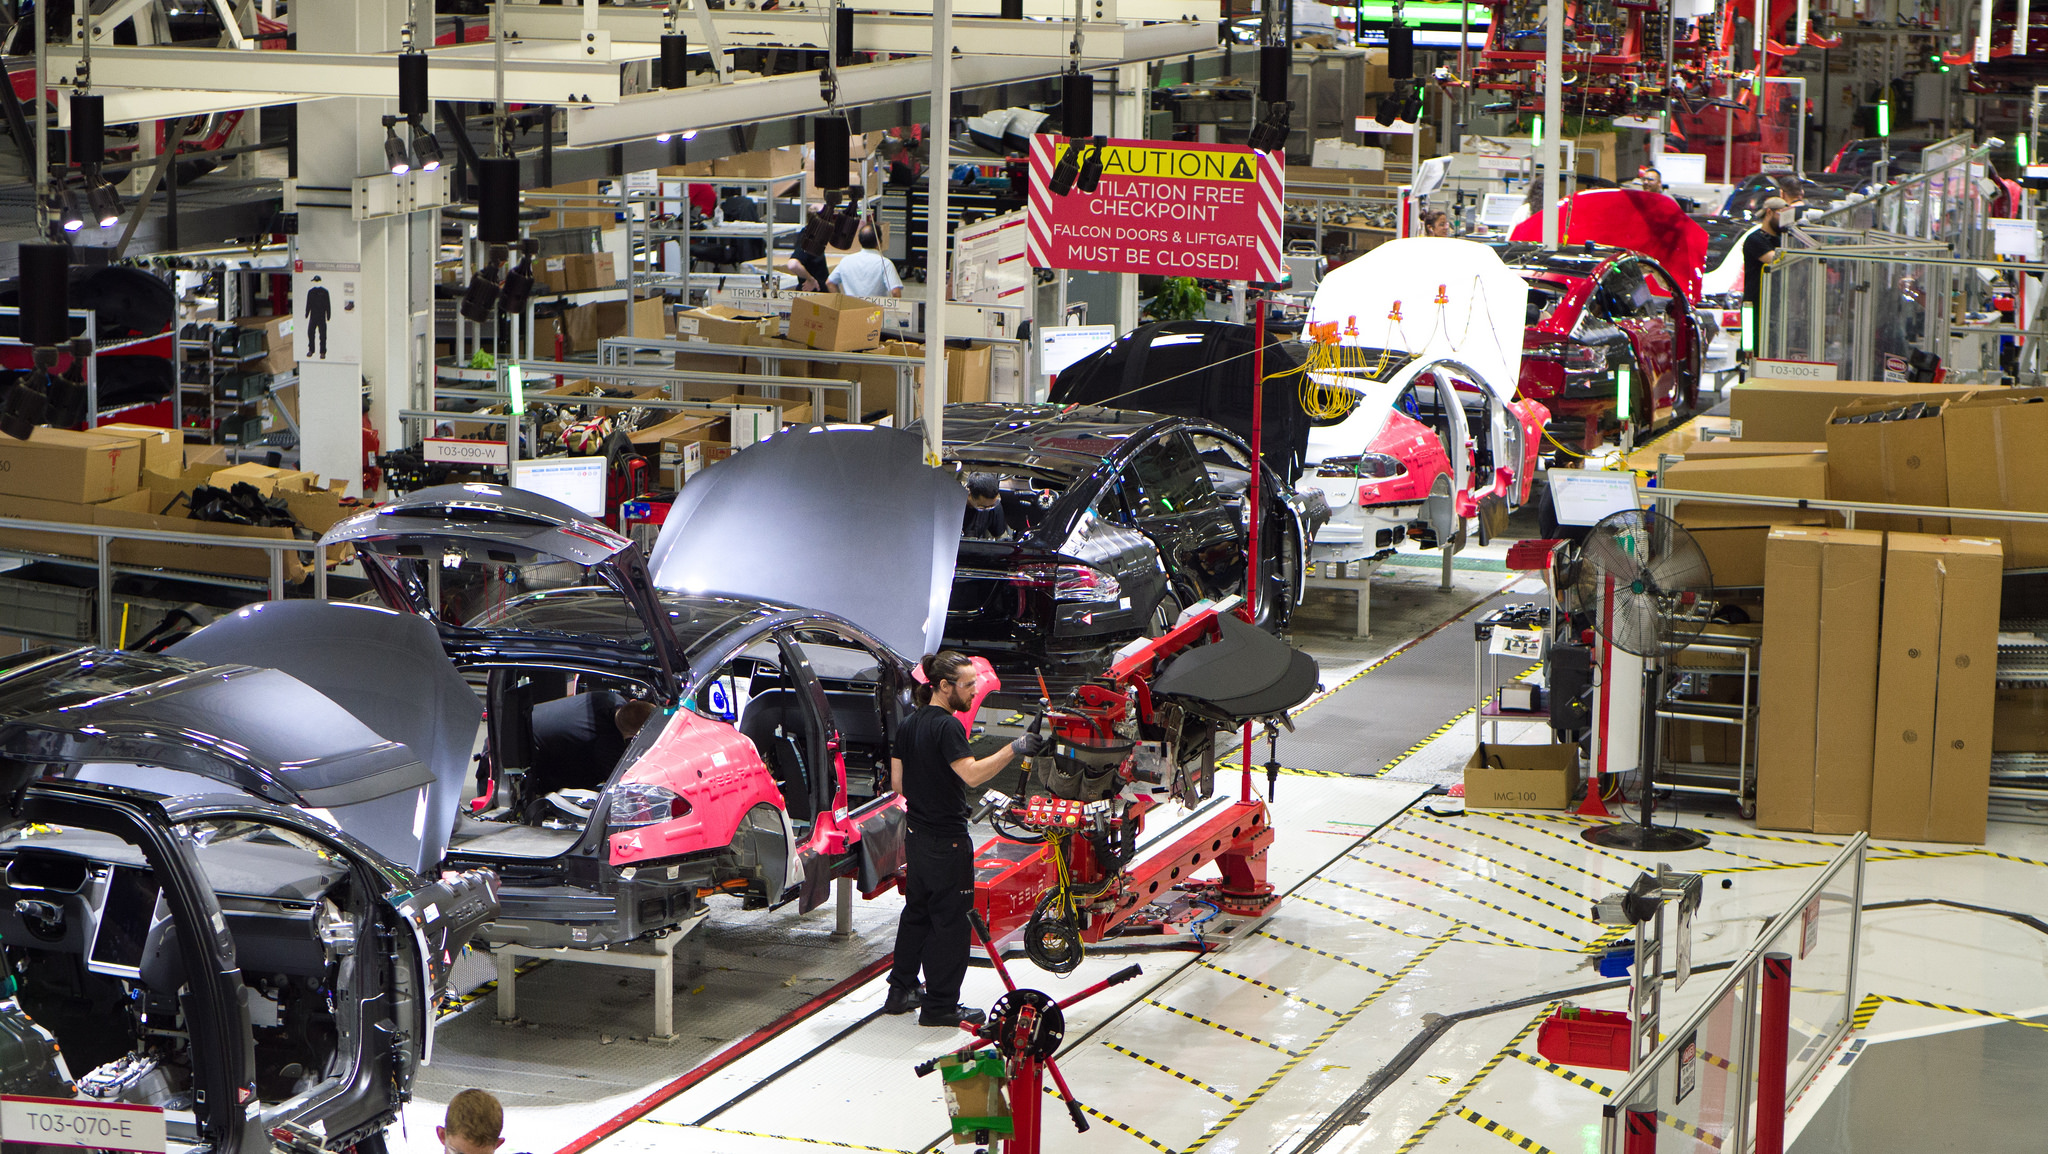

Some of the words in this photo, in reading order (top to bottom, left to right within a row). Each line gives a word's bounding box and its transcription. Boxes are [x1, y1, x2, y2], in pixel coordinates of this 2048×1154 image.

[1065, 180, 1186, 201] TILATION
[1193, 186, 1245, 204] FREE
[1089, 199, 1220, 221] CHECKPOINT
[1053, 224, 1111, 239] FALCON
[1116, 227, 1168, 242] DOORS
[1172, 231, 1182, 243] &
[1186, 232, 1255, 248] LIFTGATE
[1068, 245, 1119, 263] MUST
[1126, 248, 1150, 264] BE
[1156, 251, 1239, 270] CLOSED!
[1769, 365, 1820, 376] T03-100-E
[438, 446, 496, 458] T03-090-W
[1494, 792, 1513, 800] IMC
[1517, 792, 1537, 800] 100
[1011, 879, 1043, 909] TESLA
[26, 1113, 132, 1138] T03-070-E
